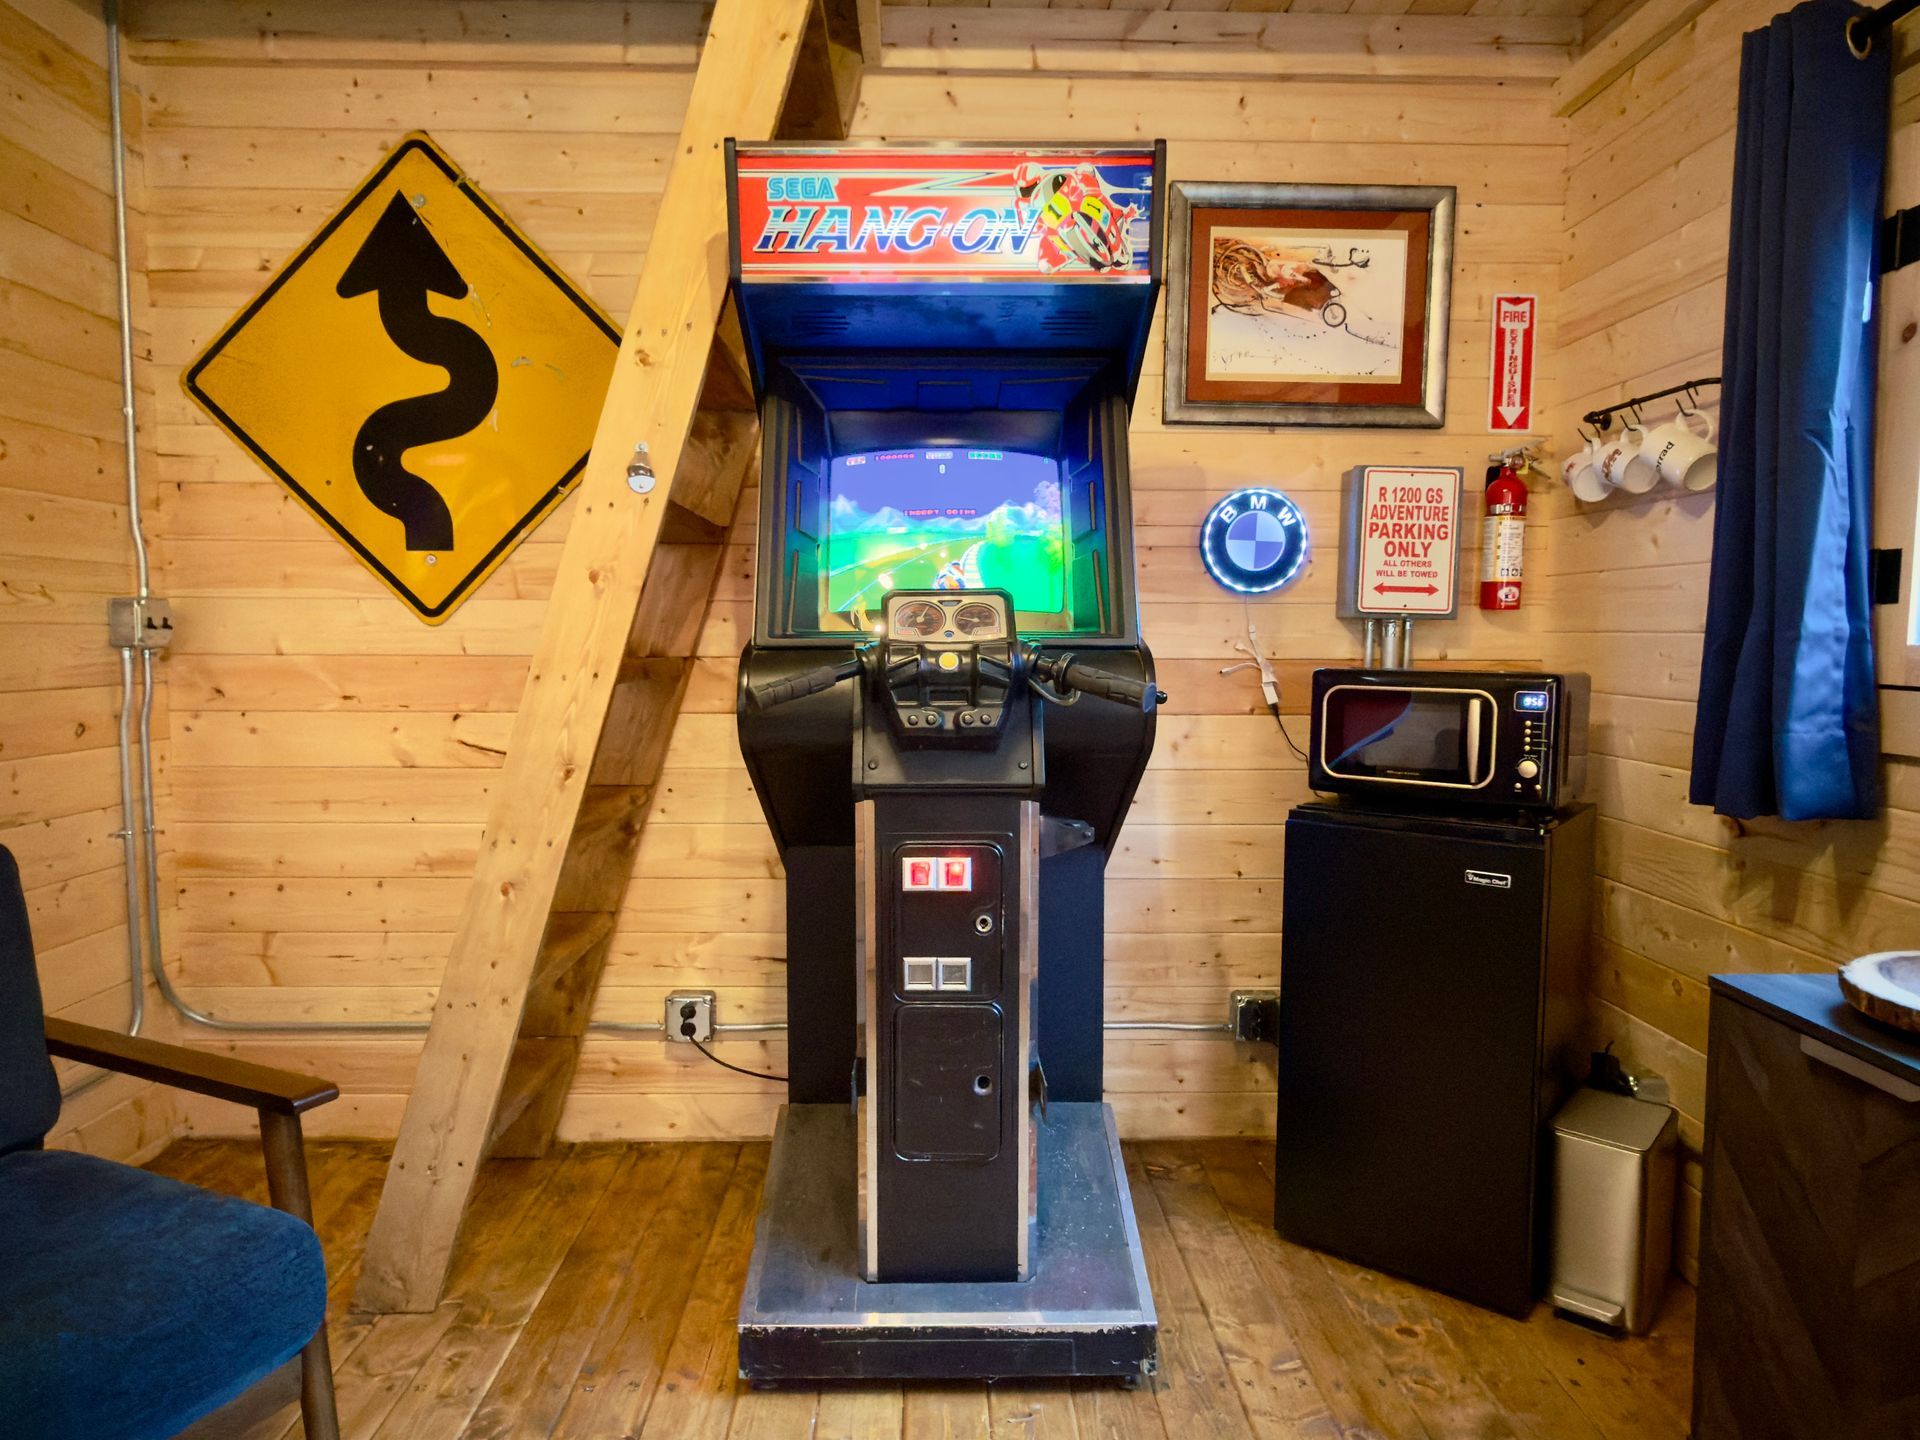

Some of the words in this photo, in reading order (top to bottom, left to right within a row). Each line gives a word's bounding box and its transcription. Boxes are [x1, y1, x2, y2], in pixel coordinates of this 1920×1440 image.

[767, 177, 836, 200] SEGA
[1503, 311, 1527, 322] FIRE
[1507, 329, 1518, 407] EXTINGUISHER
[1379, 487, 1388, 503] R
[1392, 487, 1422, 504] 1200
[1426, 488, 1443, 504] GS
[1219, 495, 1297, 527] BMW
[1370, 505, 1449, 521] ADVENTURE
[1369, 523, 1449, 541] PARKING
[1384, 541, 1432, 558] ONLY
[1400, 560, 1432, 568] OTHERS
[1376, 570, 1394, 578] WILL
[1411, 571, 1438, 579] TOWED
